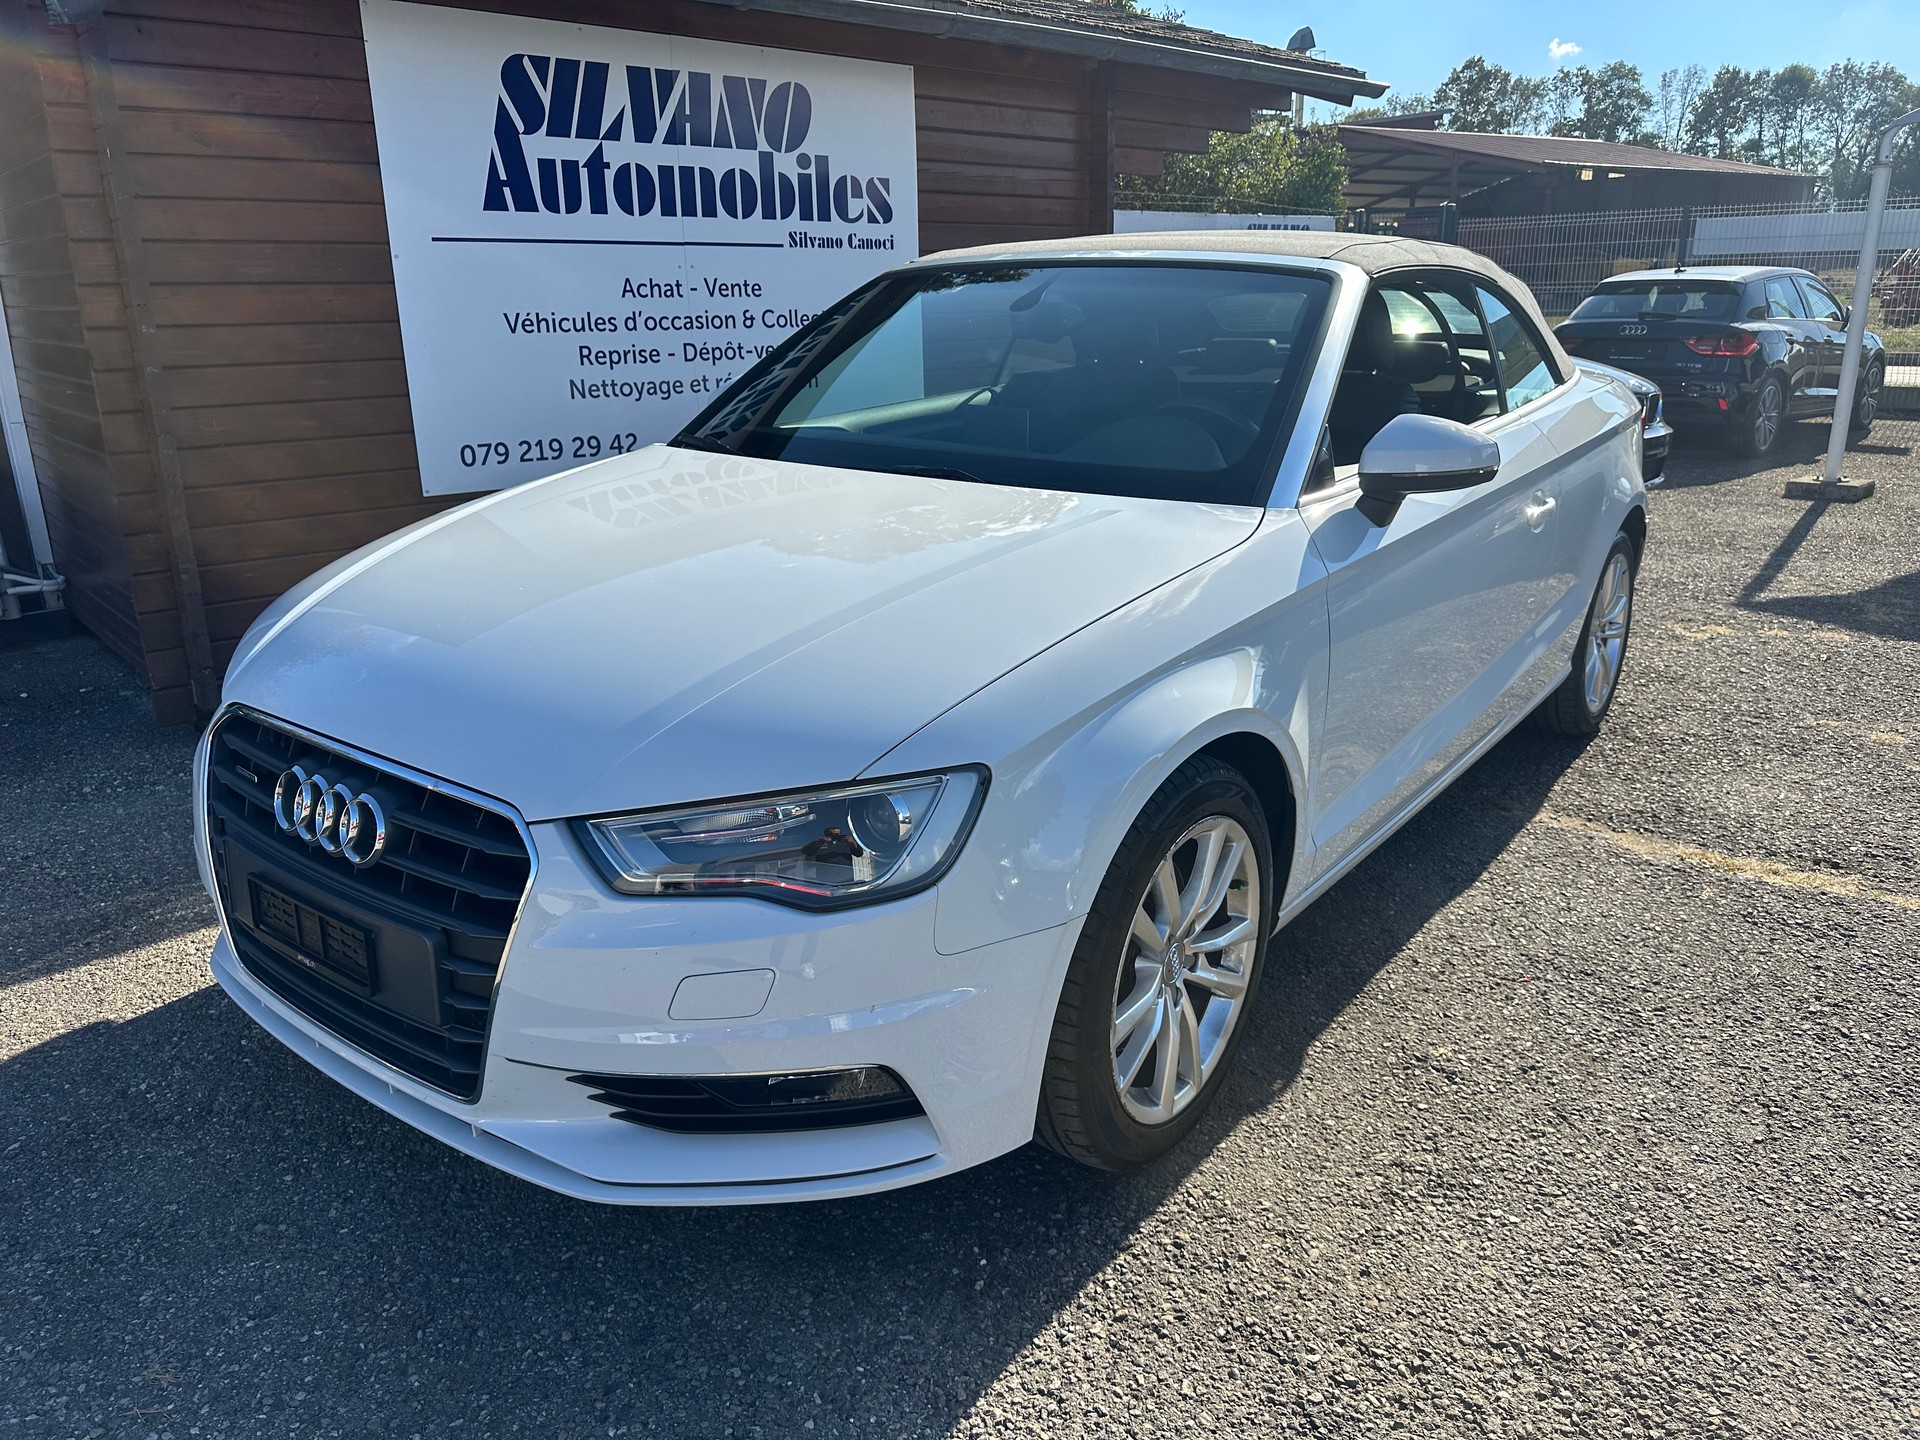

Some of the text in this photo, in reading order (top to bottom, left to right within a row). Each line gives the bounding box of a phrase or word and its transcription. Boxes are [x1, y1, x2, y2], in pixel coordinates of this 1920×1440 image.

[495, 53, 813, 154] SILVANO
[482, 132, 895, 225] Automobiles
[788, 231, 895, 251] Silvano Canoci
[621, 277, 684, 299] Achat
[703, 277, 763, 298] Vente
[503, 311, 619, 334] Véhicules
[742, 309, 756, 330] &
[578, 343, 662, 370] Reprise
[682, 340, 780, 367] Dépôt-ve
[568, 376, 685, 402] Nettoyage
[689, 374, 711, 394] et
[459, 431, 638, 468] 079 219 29 42
